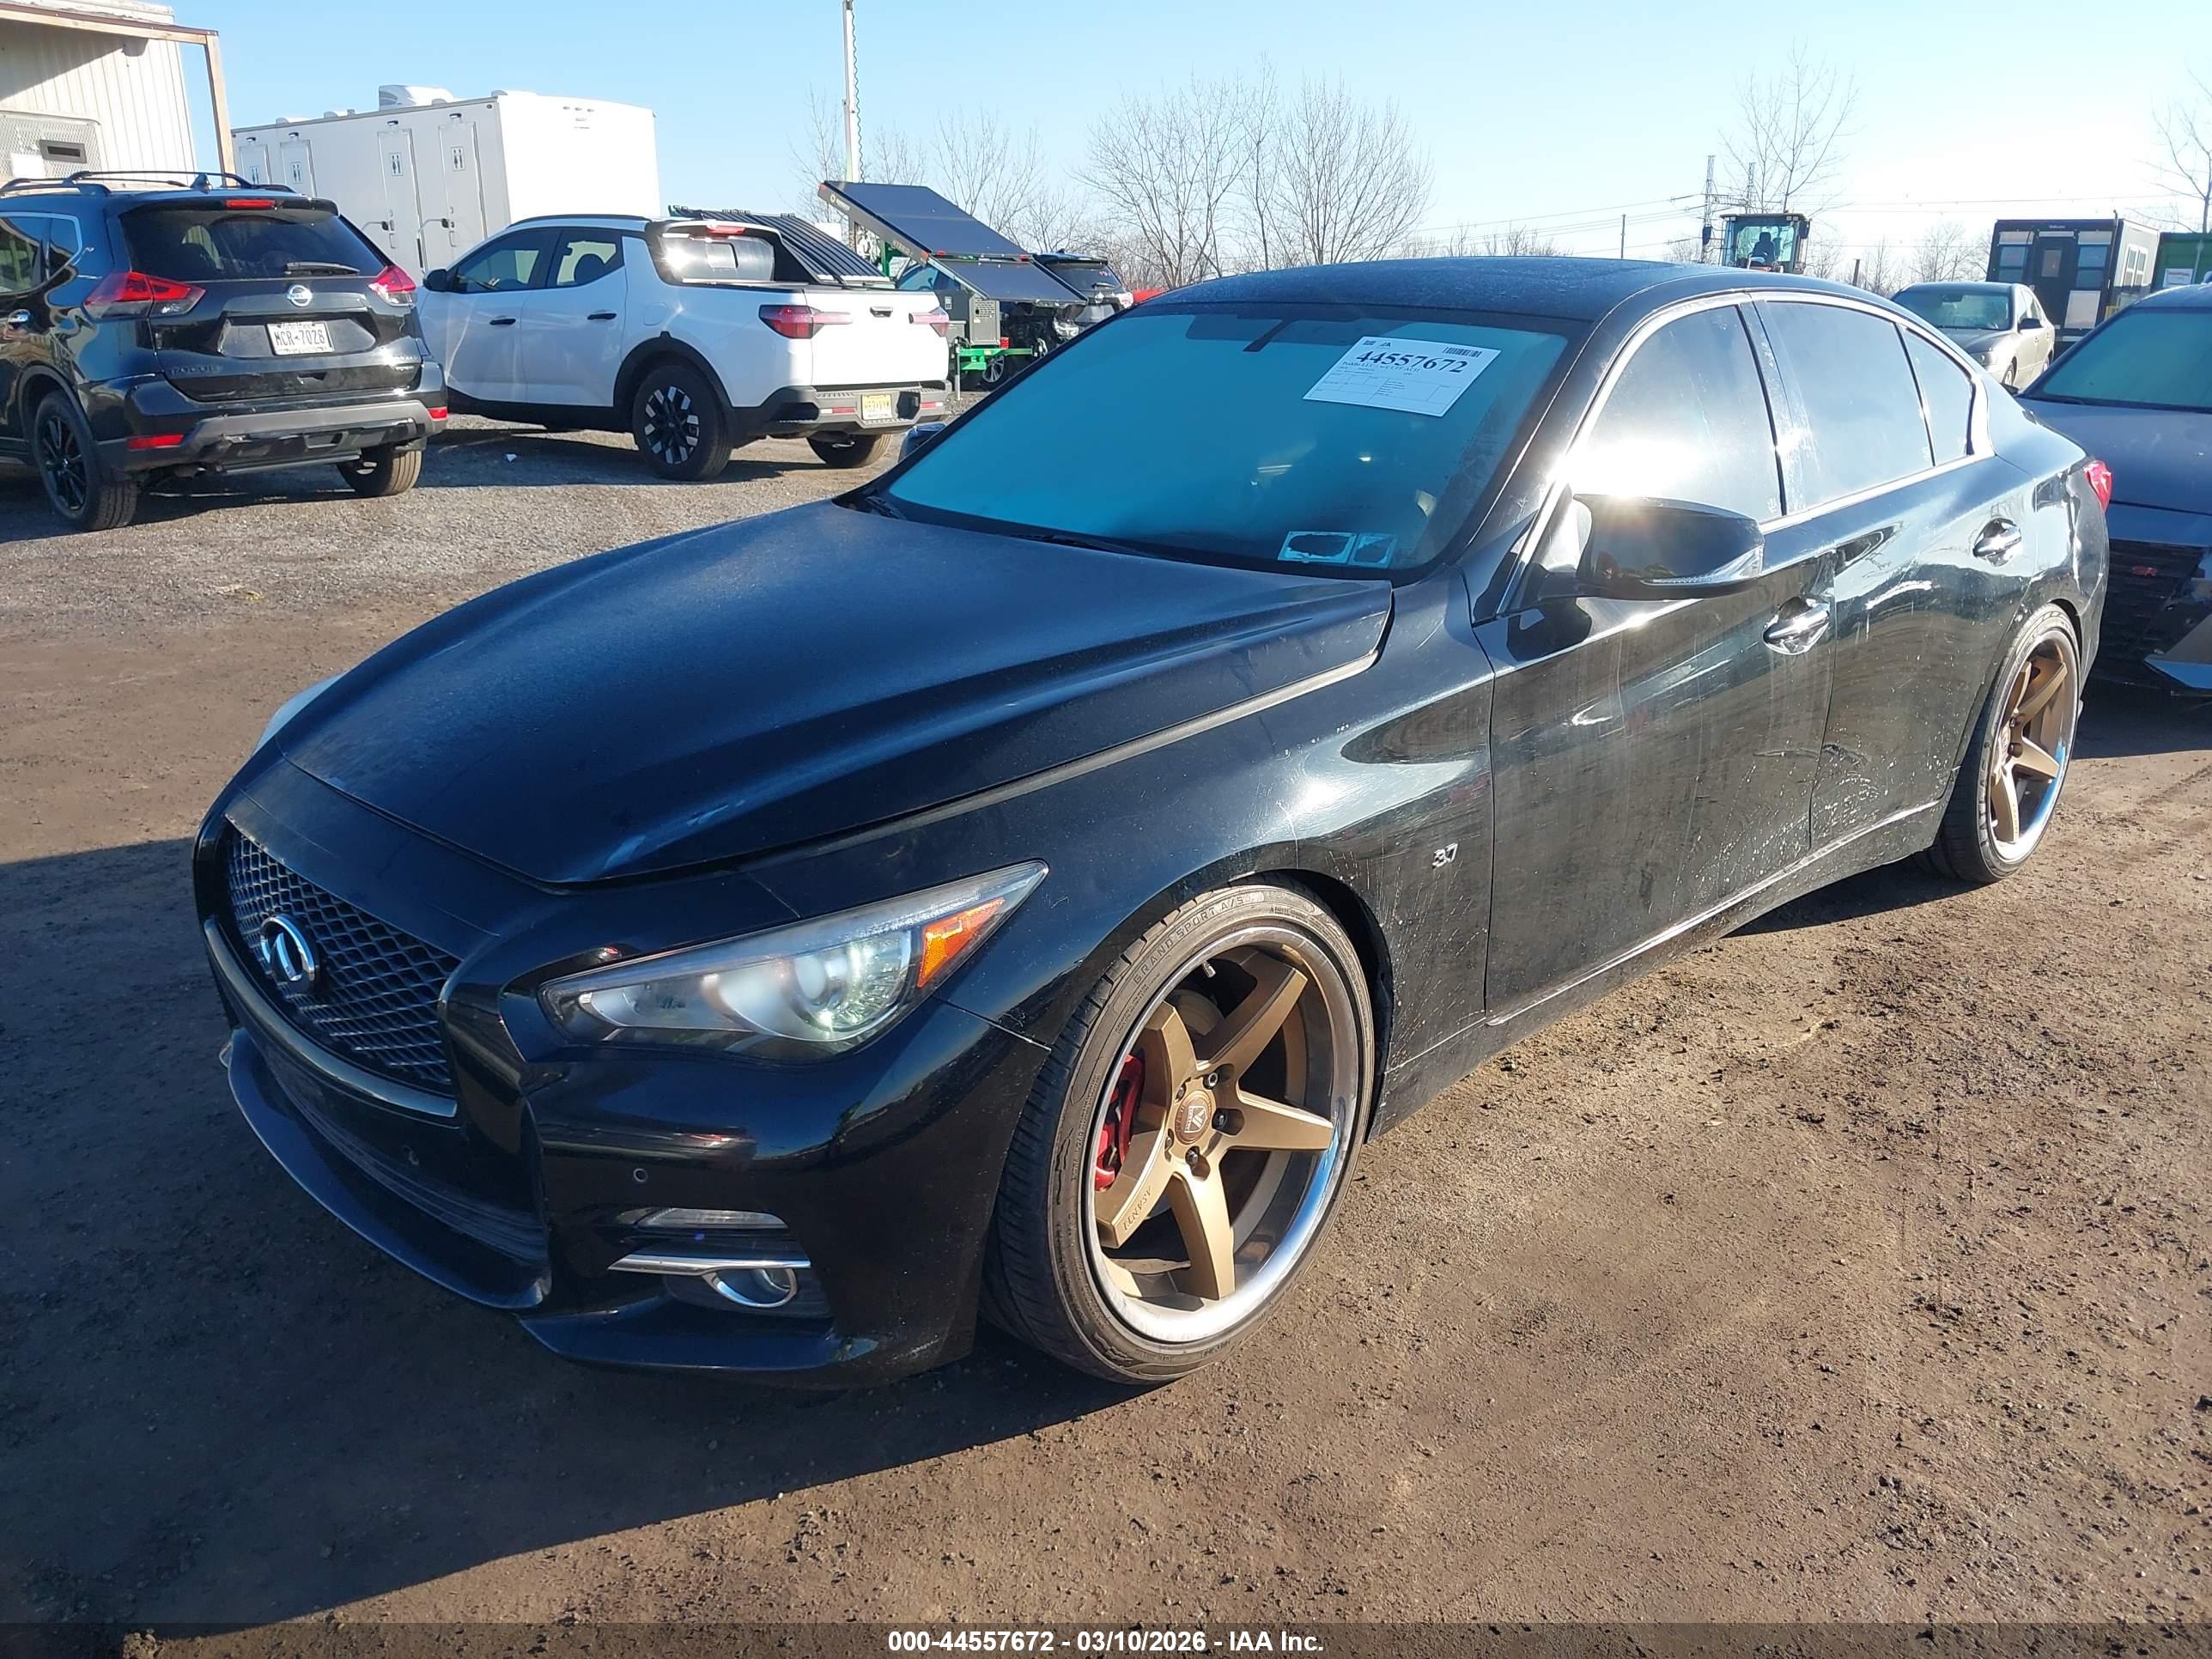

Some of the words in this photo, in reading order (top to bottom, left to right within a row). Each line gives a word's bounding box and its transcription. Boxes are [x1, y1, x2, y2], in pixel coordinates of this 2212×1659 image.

[1356, 350, 1468, 374] 44557672
[1133, 939, 1174, 985] GRAND
[1176, 907, 1216, 939] SPORT
